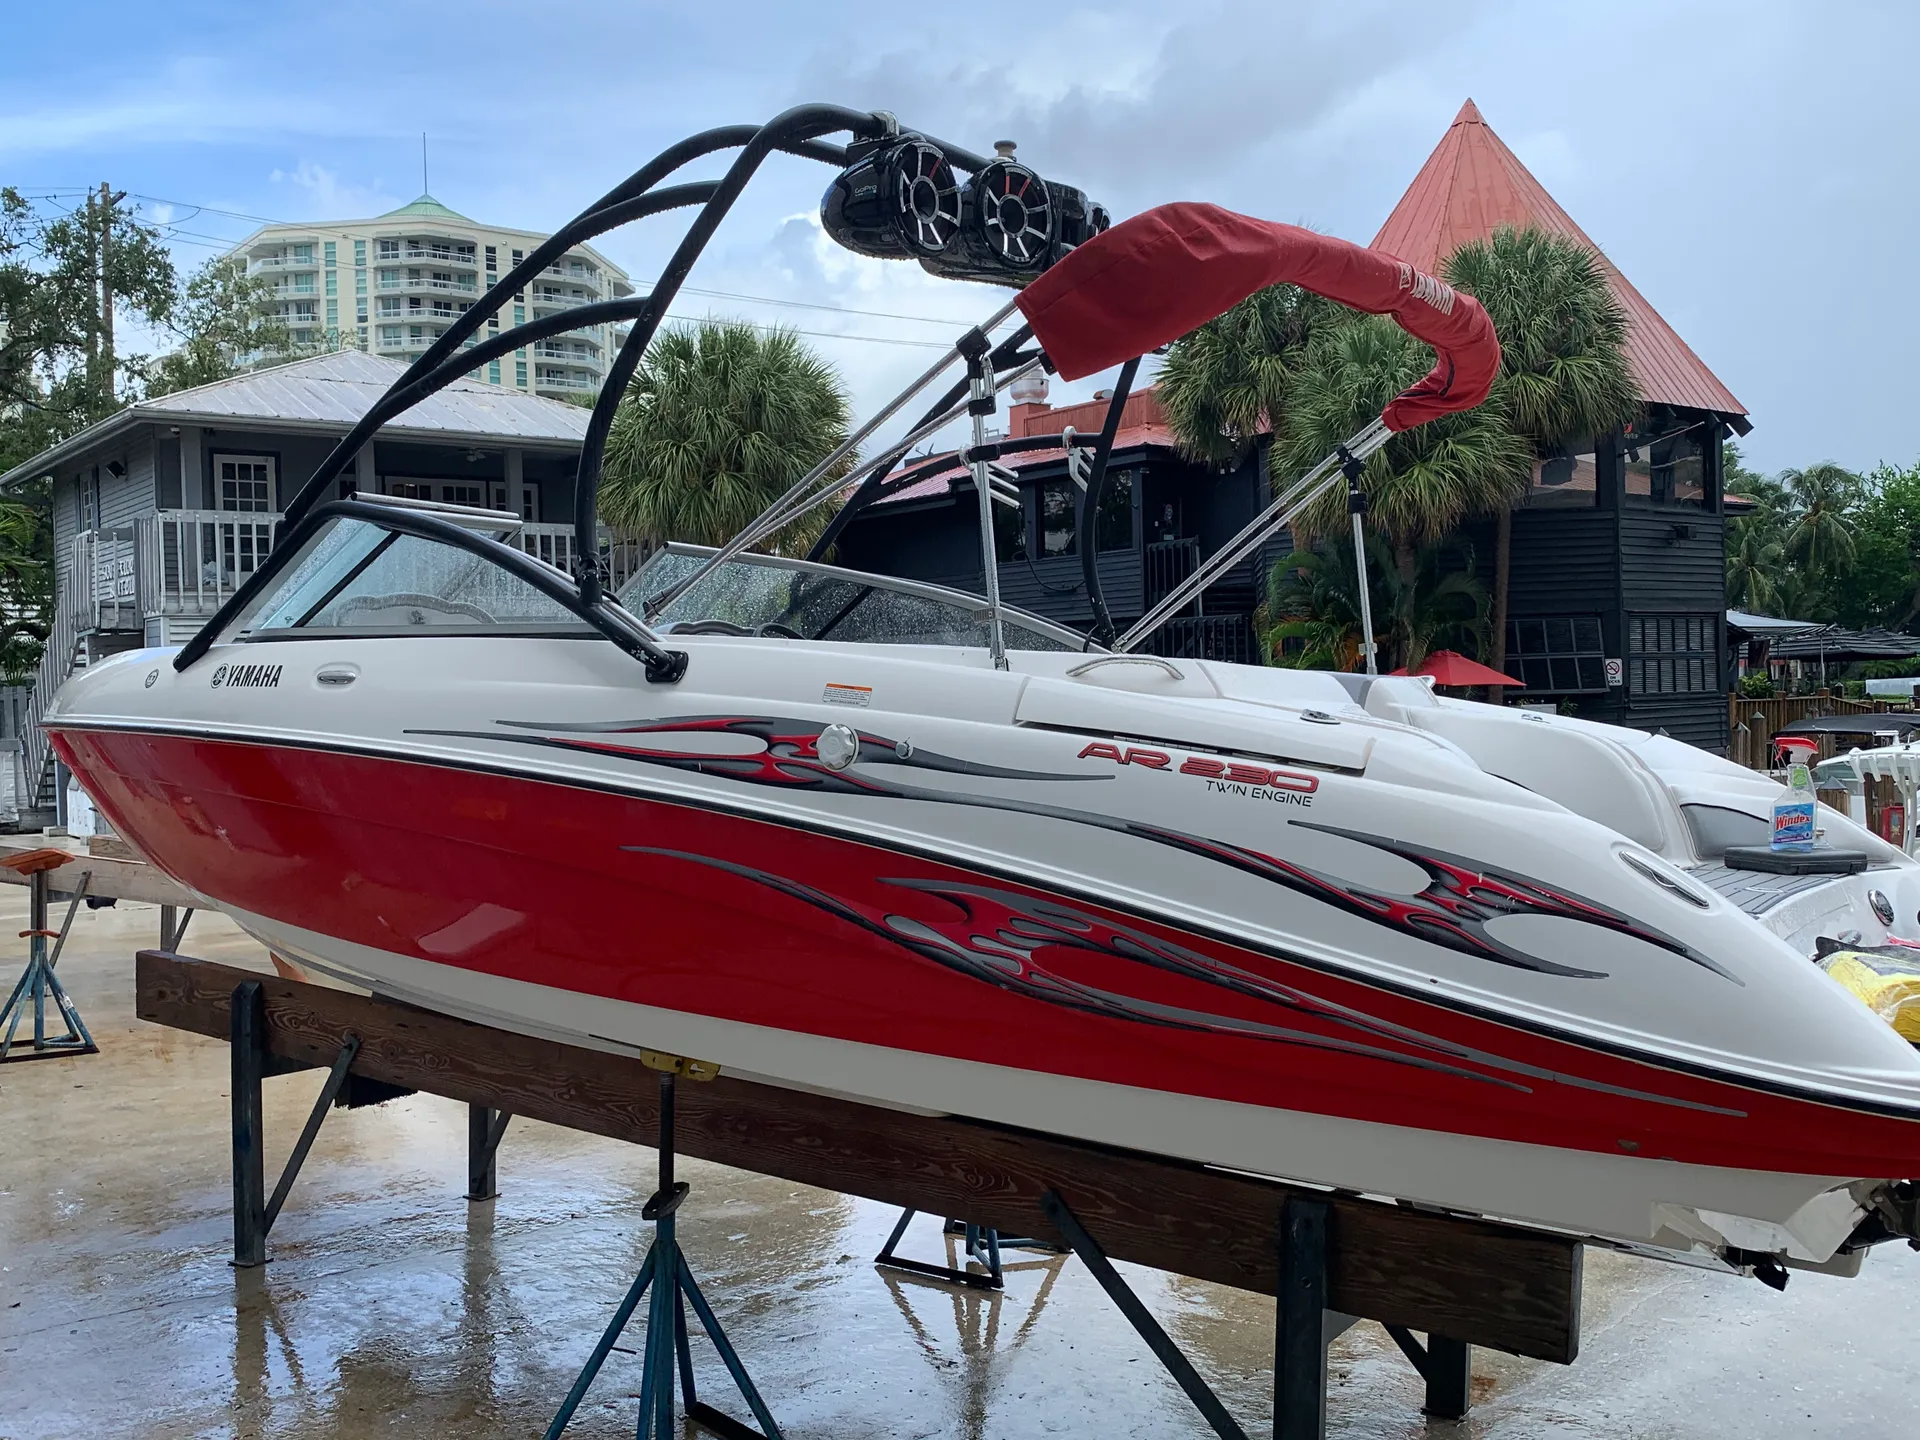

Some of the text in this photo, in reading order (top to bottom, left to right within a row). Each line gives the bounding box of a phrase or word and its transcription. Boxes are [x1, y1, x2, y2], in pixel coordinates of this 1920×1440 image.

[226, 665, 283, 687] YAMAHA
[1077, 742, 1320, 793] AR 230
[1206, 780, 1314, 807] TWIN ENGINE
[1776, 814, 1811, 831] Windex
